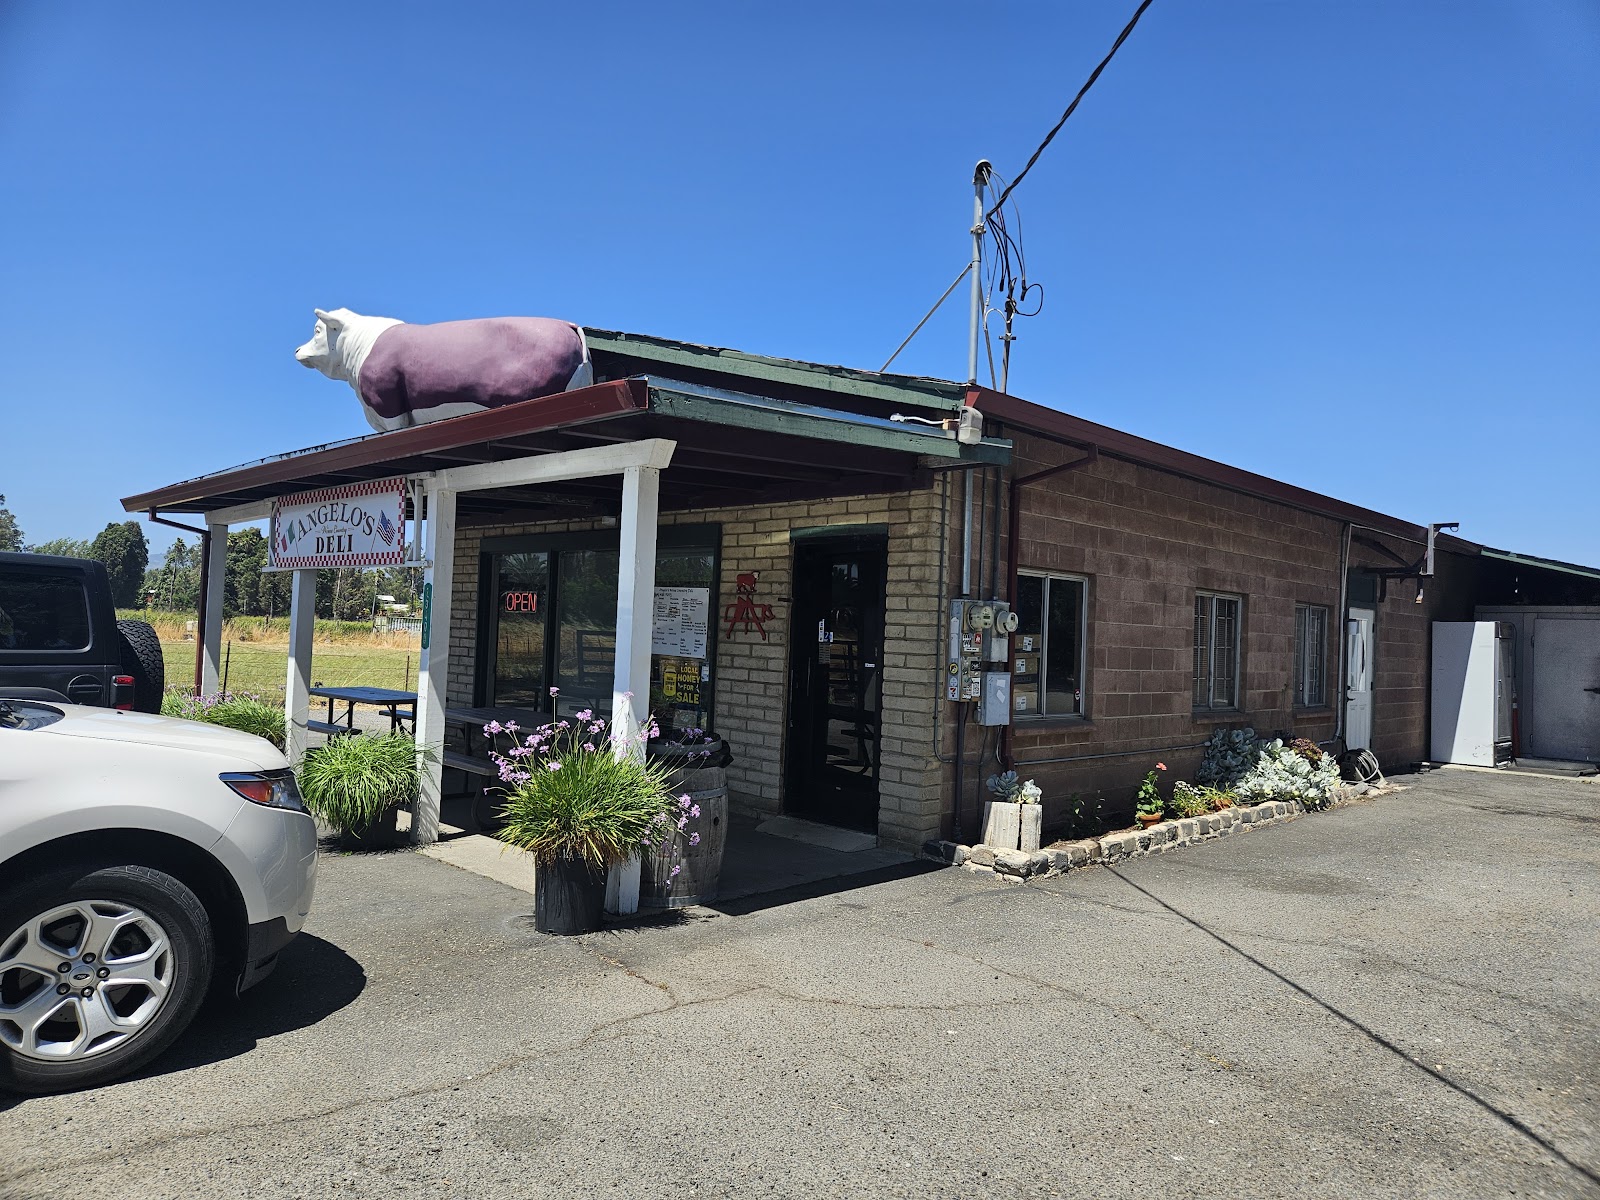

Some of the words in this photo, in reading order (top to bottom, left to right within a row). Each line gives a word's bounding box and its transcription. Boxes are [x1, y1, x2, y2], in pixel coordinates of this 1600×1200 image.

[297, 501, 375, 542] ANGELO'S
[315, 534, 353, 554] DELI
[507, 593, 537, 611] OPEN
[680, 666, 699, 674] LOCAL
[677, 674, 701, 684] HONEY
[683, 684, 694, 692] FOR
[676, 691, 700, 705] SALE
